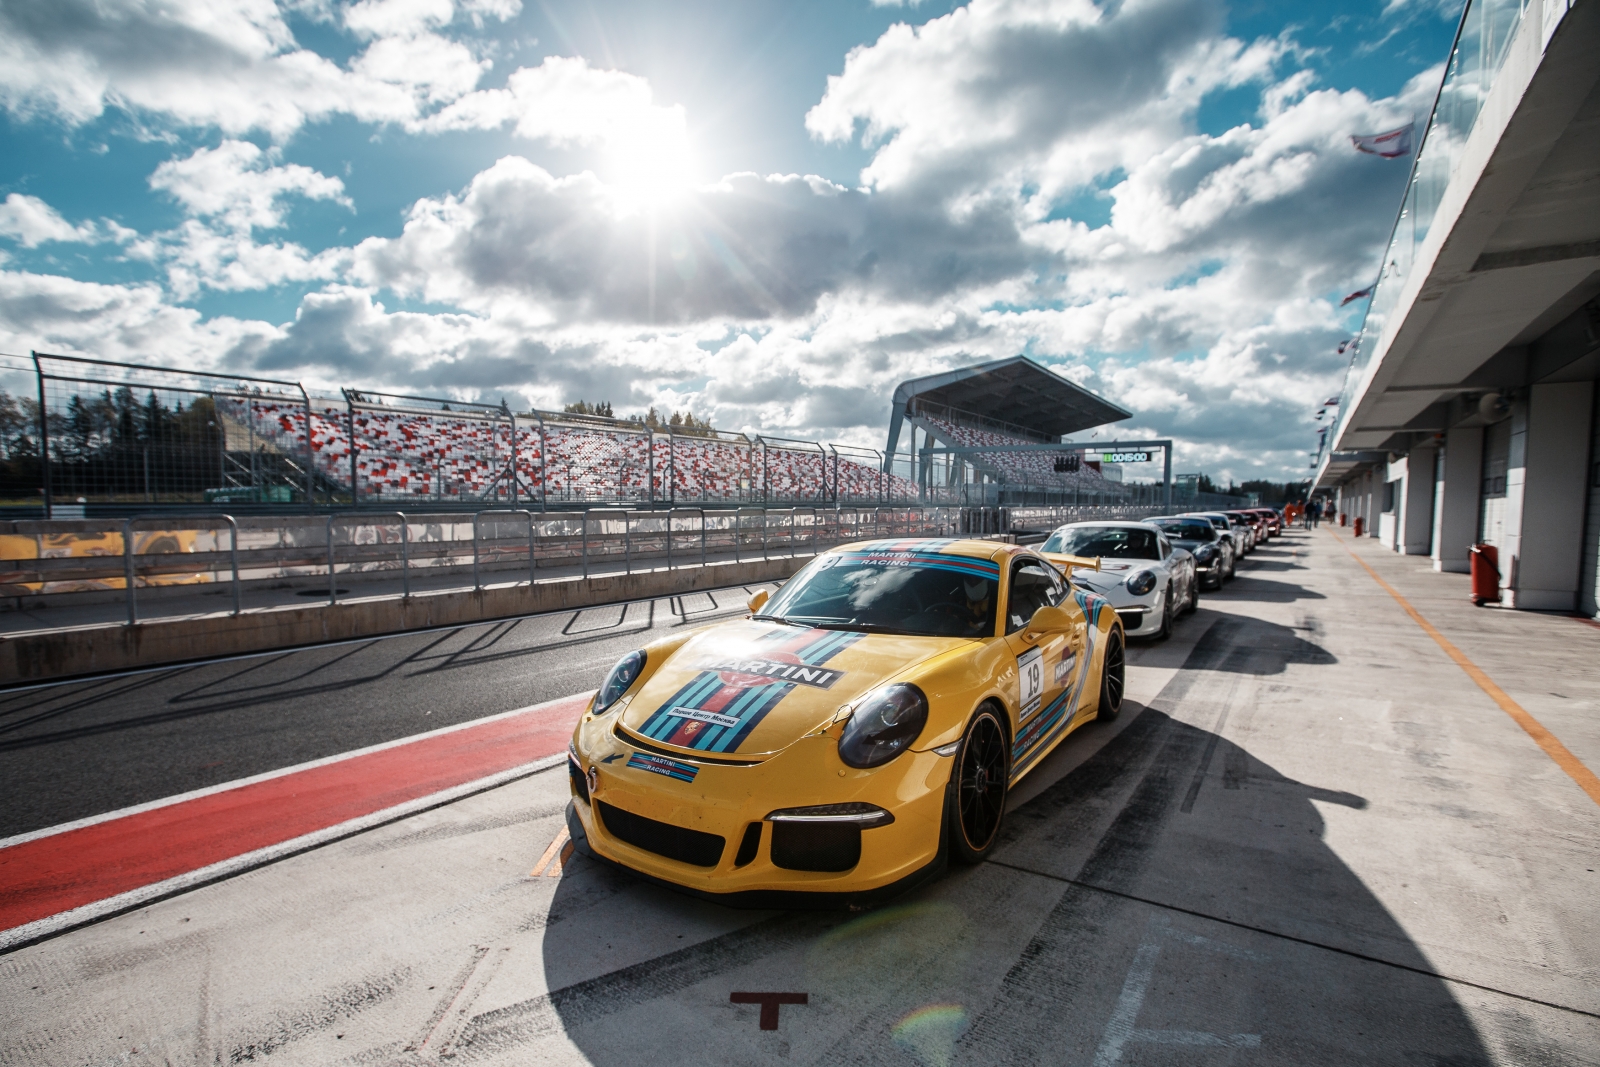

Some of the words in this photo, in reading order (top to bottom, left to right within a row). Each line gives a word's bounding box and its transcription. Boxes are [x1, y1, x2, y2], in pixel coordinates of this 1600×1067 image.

[868, 551, 917, 559] MARTINI
[861, 559, 910, 567] RACING
[695, 655, 834, 685] MARTINI
[1027, 663, 1040, 699] 19
[672, 708, 693, 716] Порше
[692, 711, 711, 720] Центр
[711, 714, 736, 725] Москва
[650, 755, 676, 767] MARTINI
[646, 764, 671, 776] RACING
